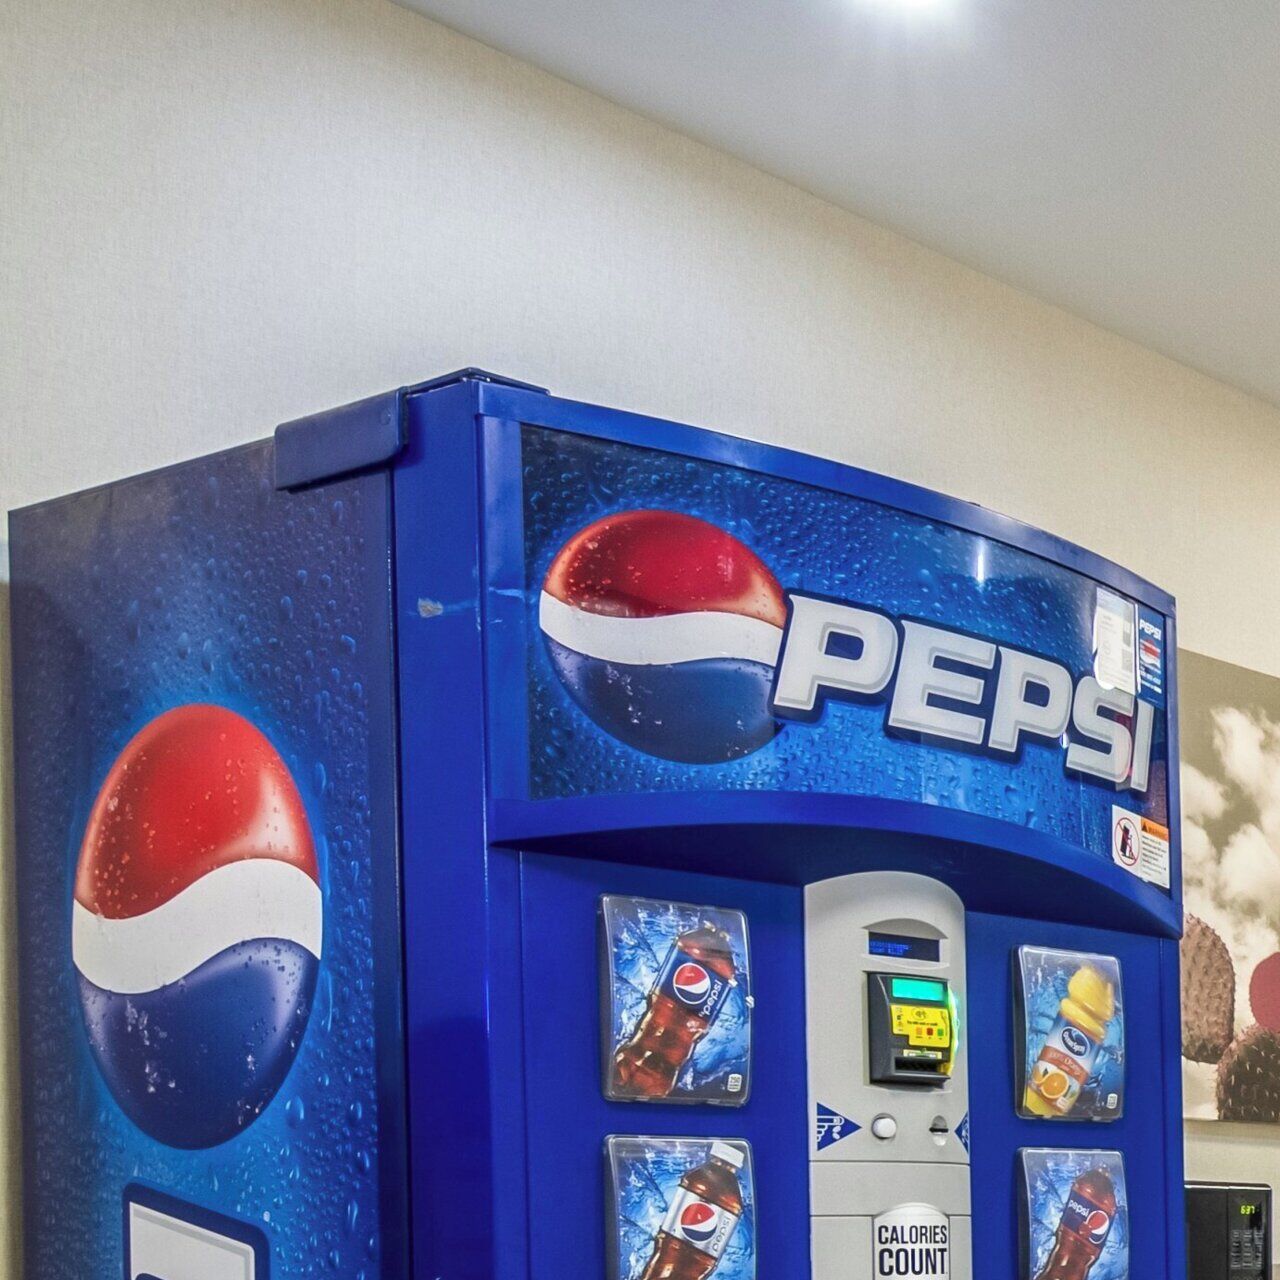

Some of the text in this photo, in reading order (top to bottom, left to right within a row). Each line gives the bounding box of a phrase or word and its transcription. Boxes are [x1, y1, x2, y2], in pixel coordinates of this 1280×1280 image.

[1139, 618, 1161, 640] PEPSI
[773, 592, 1154, 792] PEPSI
[702, 979, 722, 1016] pepsi
[1067, 1199, 1090, 1218] pepsi
[878, 1225, 947, 1246] CALORIES
[878, 1247, 947, 1276] COUNT
